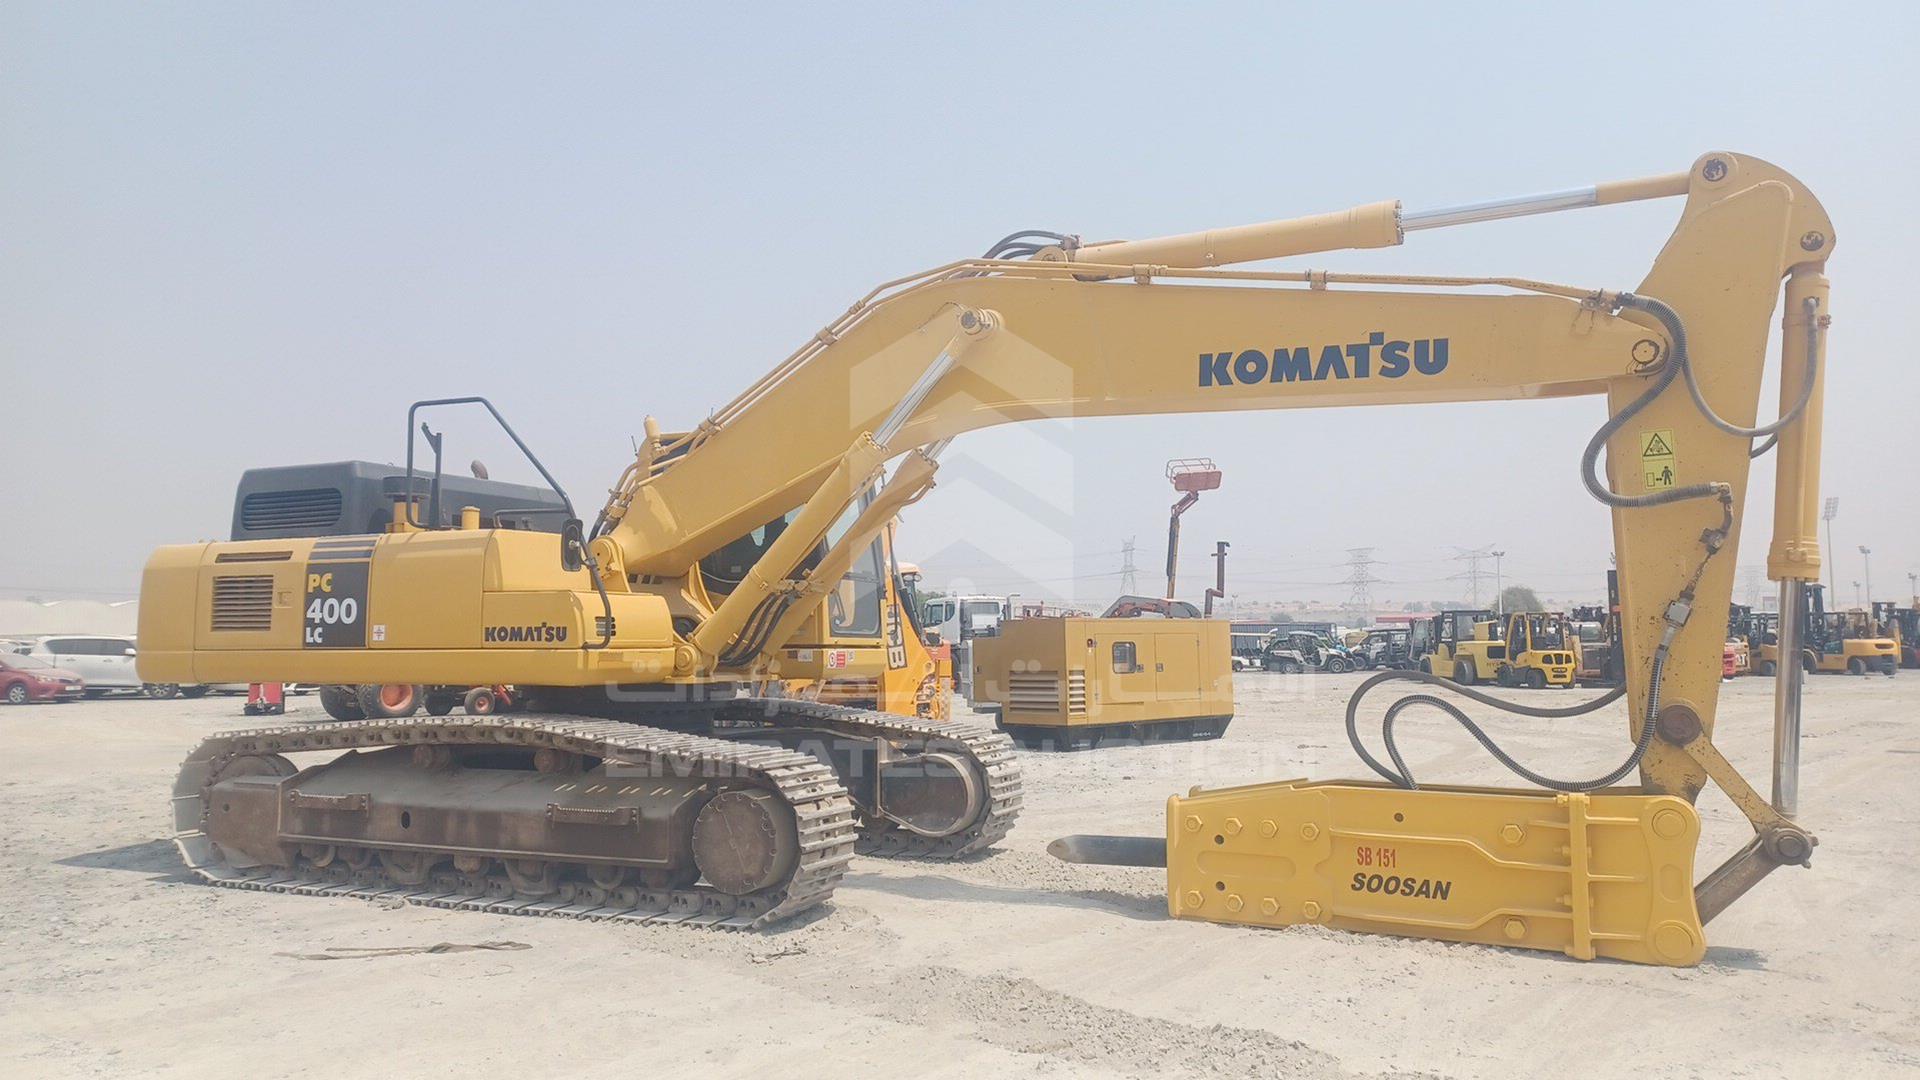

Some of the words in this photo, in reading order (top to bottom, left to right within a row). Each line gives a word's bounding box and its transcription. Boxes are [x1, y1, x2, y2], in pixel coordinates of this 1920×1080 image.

[1198, 331, 1449, 388] KOMATSU
[307, 572, 333, 593] PC
[306, 597, 358, 625] 400
[305, 626, 323, 643] LC
[484, 621, 568, 642] KOMATSU
[1357, 846, 1373, 866] SB
[1376, 848, 1396, 868] 151
[1350, 872, 1452, 900] SOOSAN
